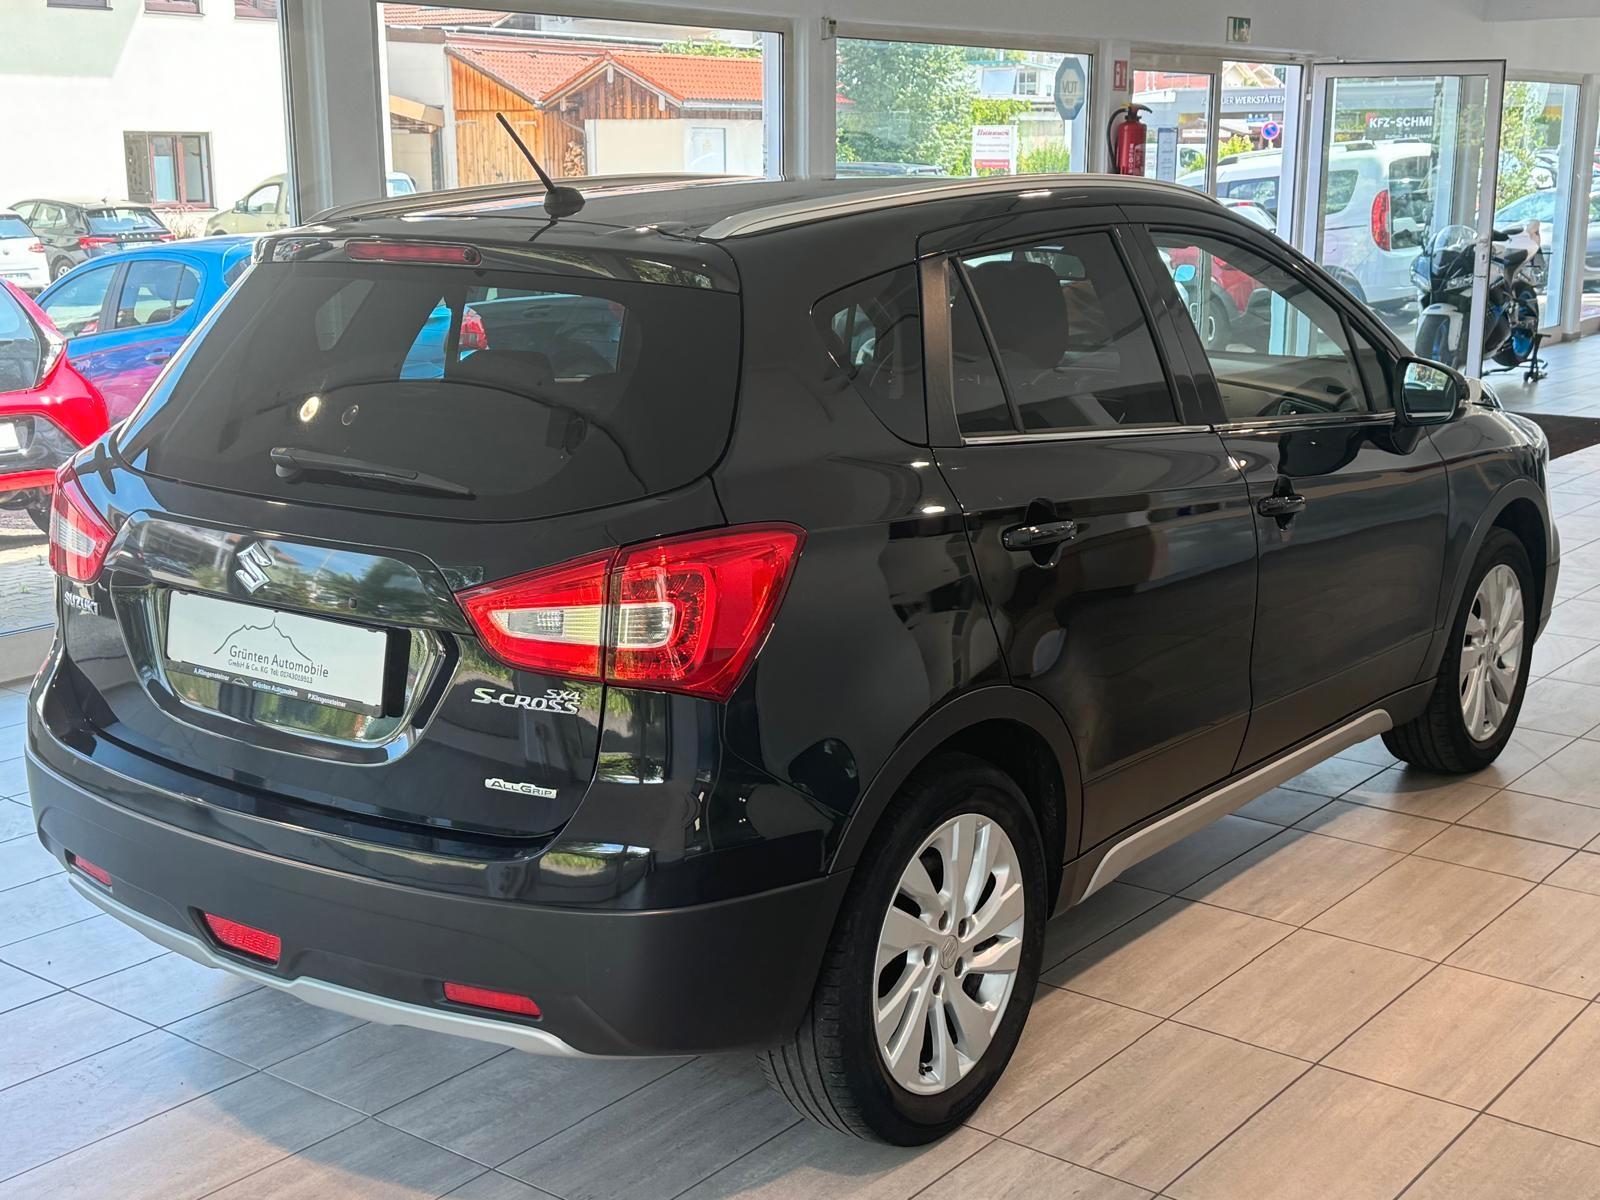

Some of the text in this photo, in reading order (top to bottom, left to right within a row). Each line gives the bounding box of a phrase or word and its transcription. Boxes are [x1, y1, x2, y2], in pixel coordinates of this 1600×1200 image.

[64, 591, 98, 616] SUZUKI
[228, 659, 244, 669] GmbH
[260, 666, 268, 674] KG
[229, 644, 329, 678] Grünten Automobile
[471, 687, 580, 715] S-CROSS
[544, 688, 581, 701] SX4
